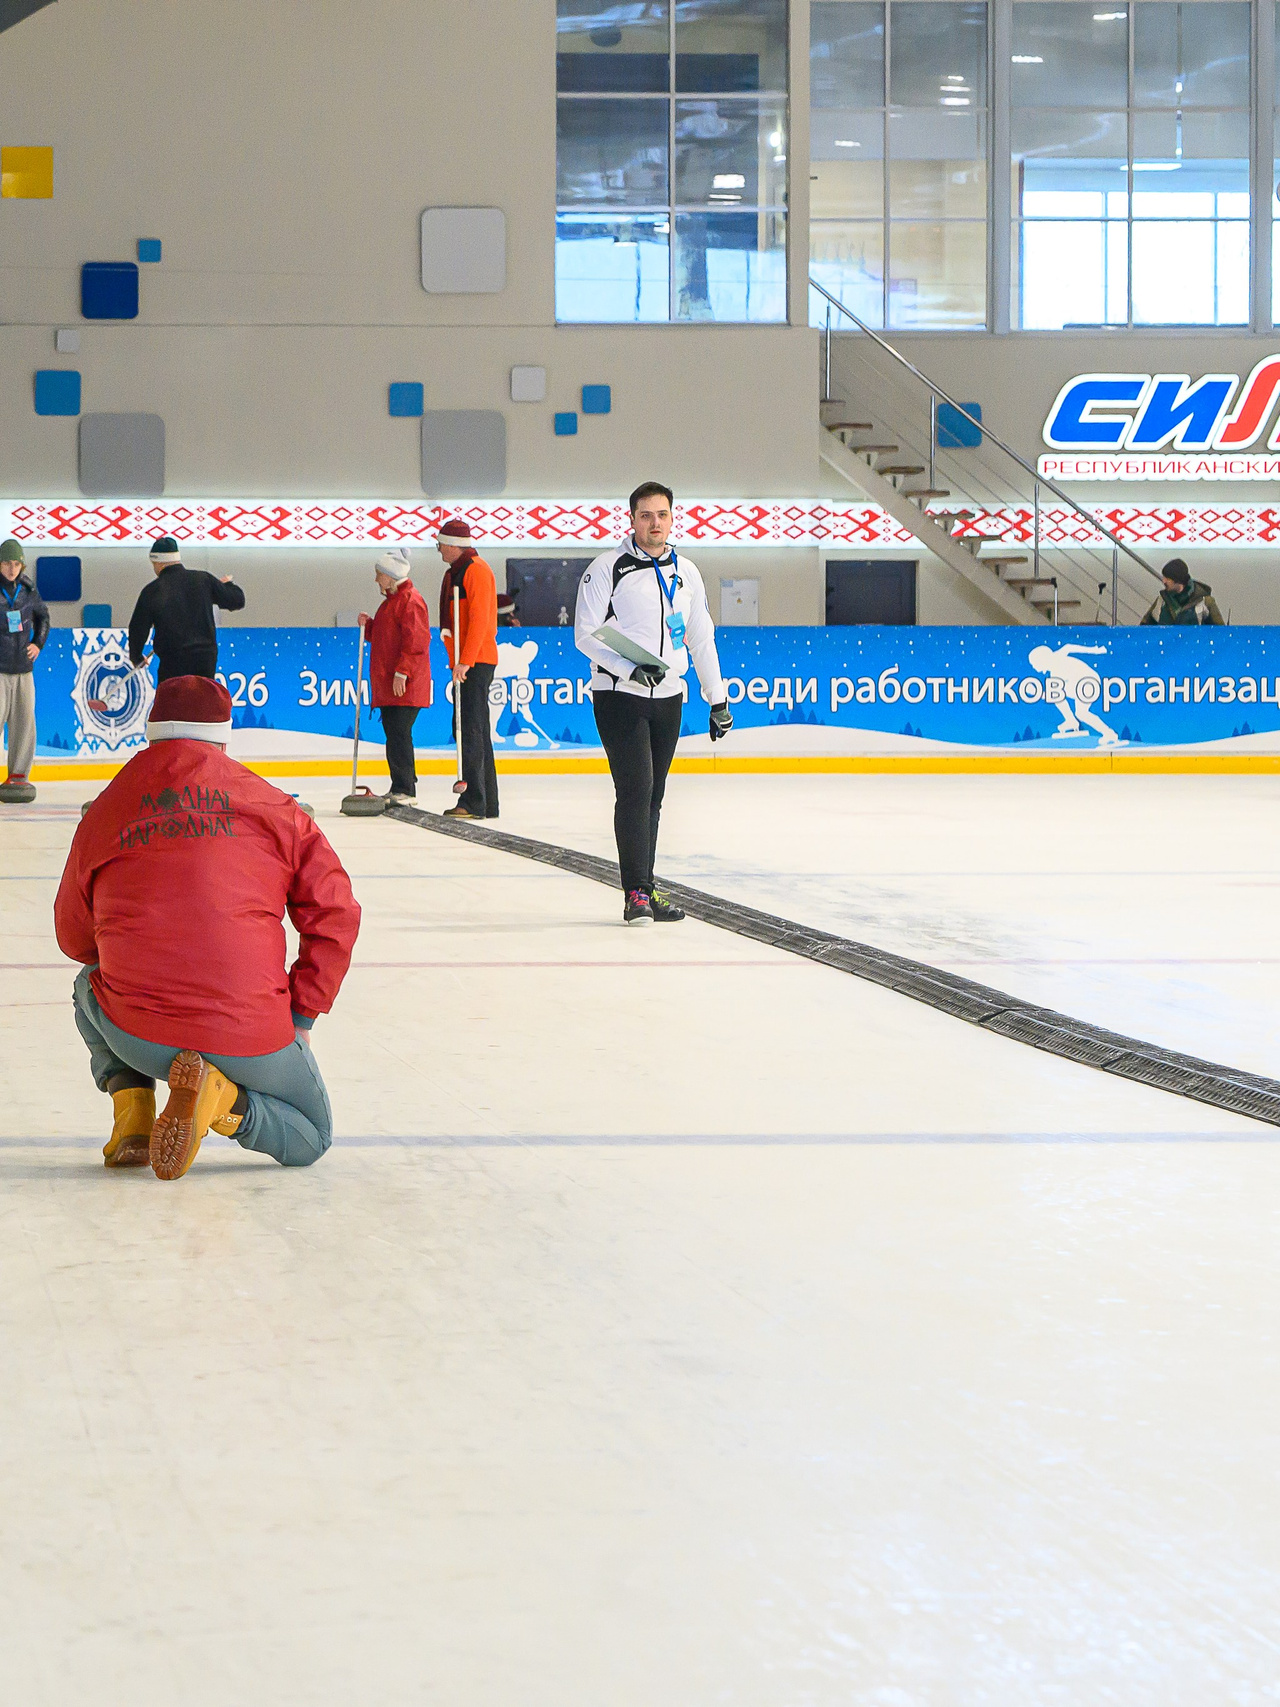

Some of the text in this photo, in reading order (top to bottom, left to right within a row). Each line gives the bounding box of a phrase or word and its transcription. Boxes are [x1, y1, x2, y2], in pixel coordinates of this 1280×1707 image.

[701, 676, 818, 711] реди
[830, 662, 1066, 712] работников
[1075, 676, 1280, 712] организац
